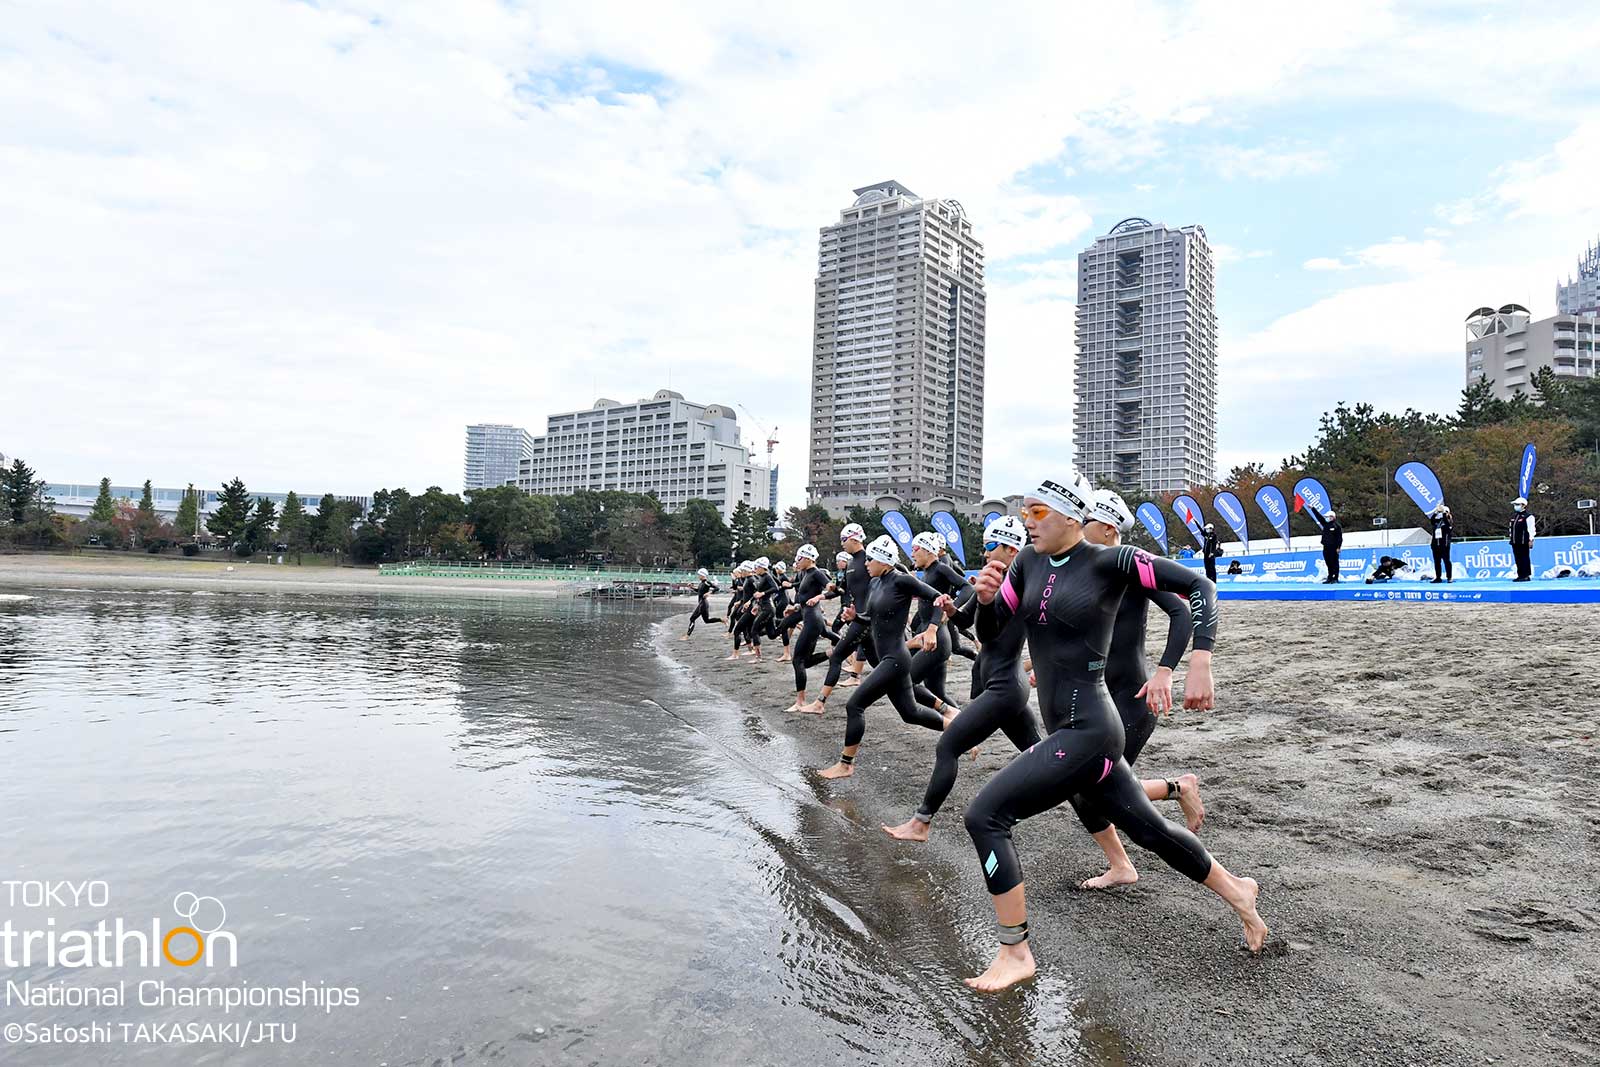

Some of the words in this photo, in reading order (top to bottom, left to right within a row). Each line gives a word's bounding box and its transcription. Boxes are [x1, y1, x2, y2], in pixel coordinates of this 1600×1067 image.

[1050, 482, 1081, 505] HUUB
[1465, 546, 1512, 568] FUJITSU
[1554, 541, 1600, 566] FUJITS
